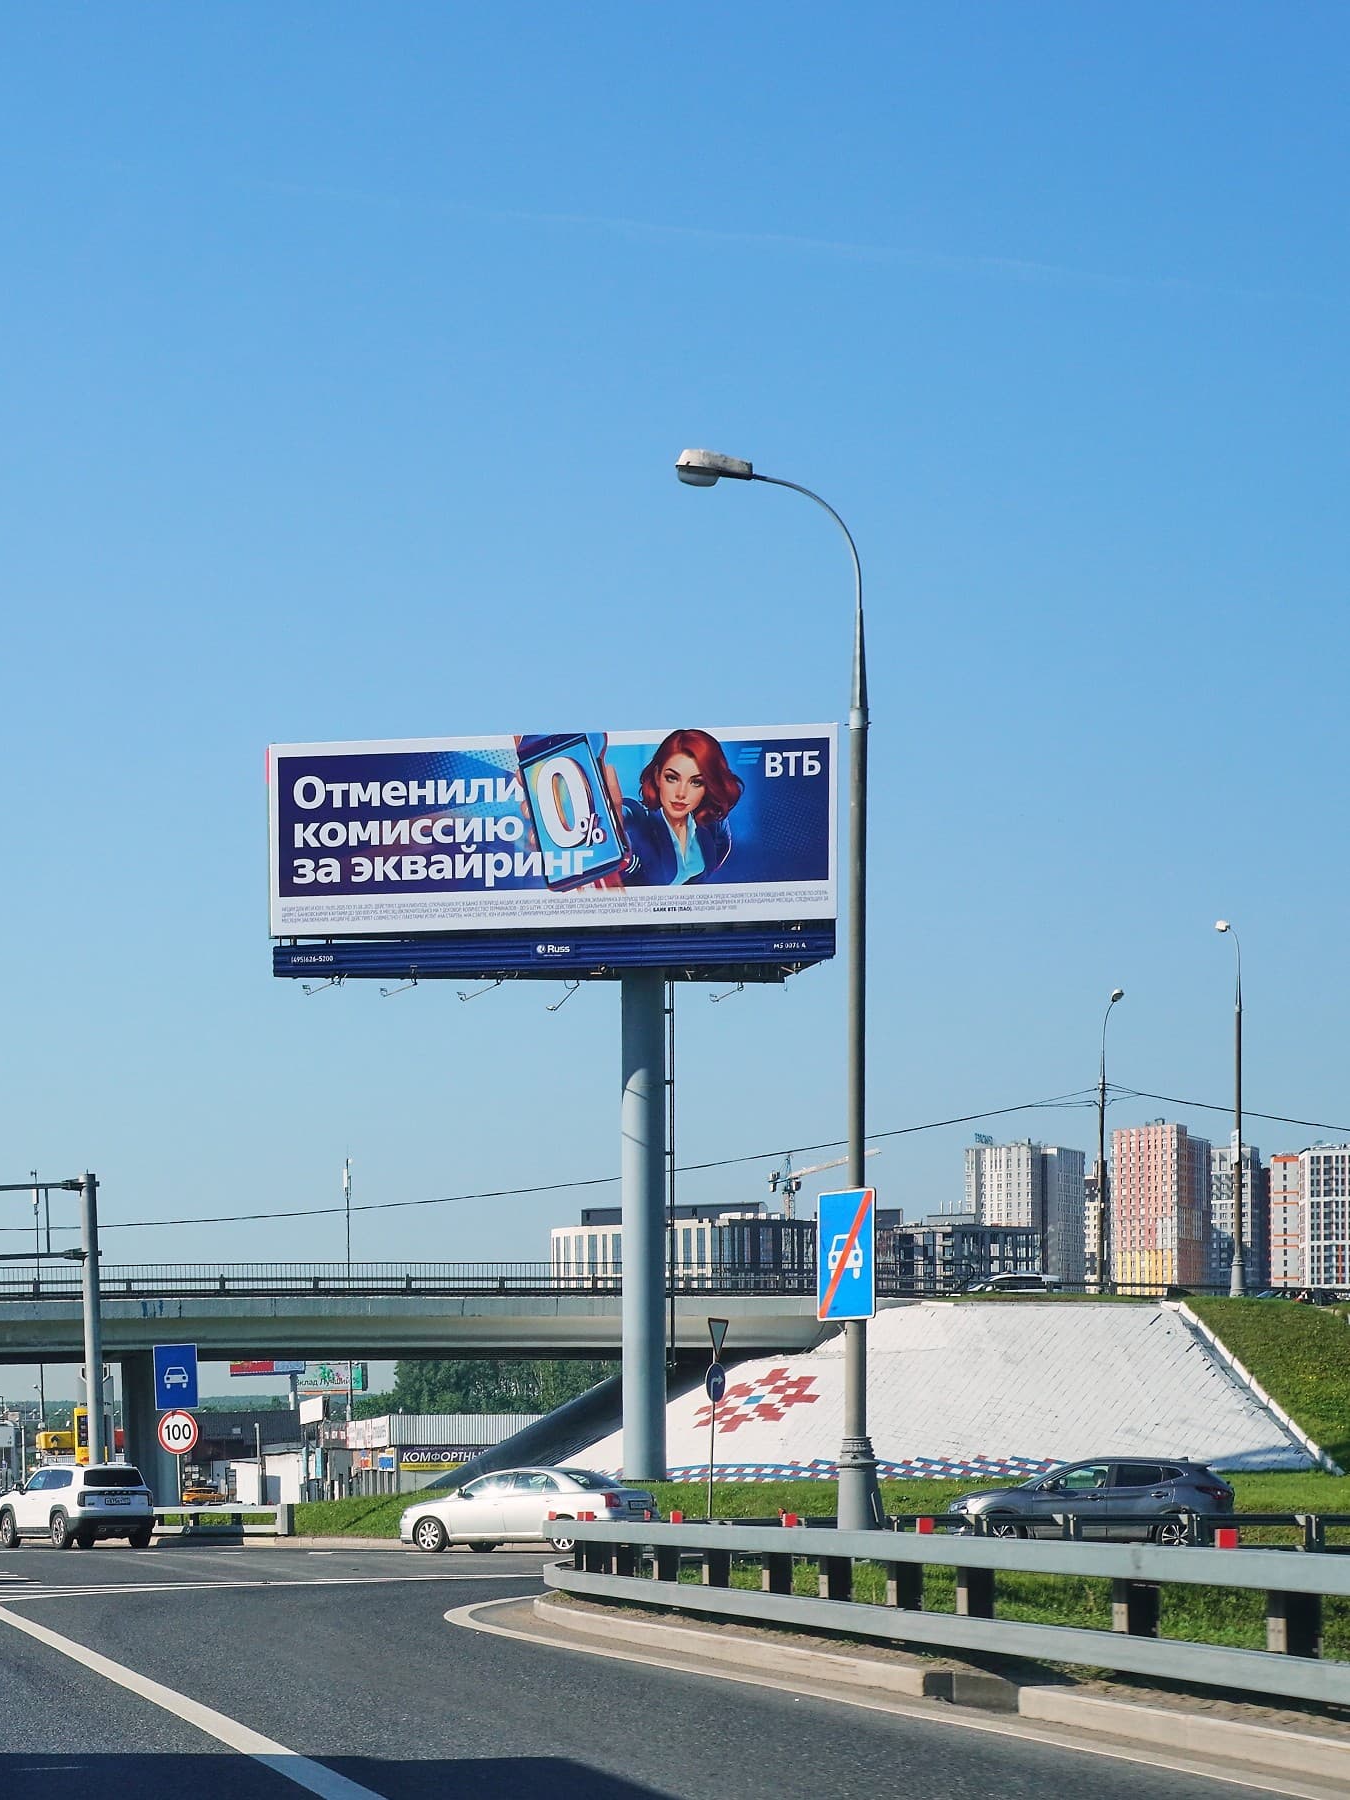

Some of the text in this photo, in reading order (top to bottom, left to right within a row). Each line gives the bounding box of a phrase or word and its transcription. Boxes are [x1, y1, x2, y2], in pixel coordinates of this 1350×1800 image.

[764, 750, 821, 778] ВТБ
[293, 775, 524, 810] Отменили
[293, 815, 524, 848] комиссию
[292, 844, 593, 887] за эквайринг
[547, 944, 571, 953] Russ
[319, 1376, 350, 1387] Лучший
[165, 1423, 192, 1441] 100
